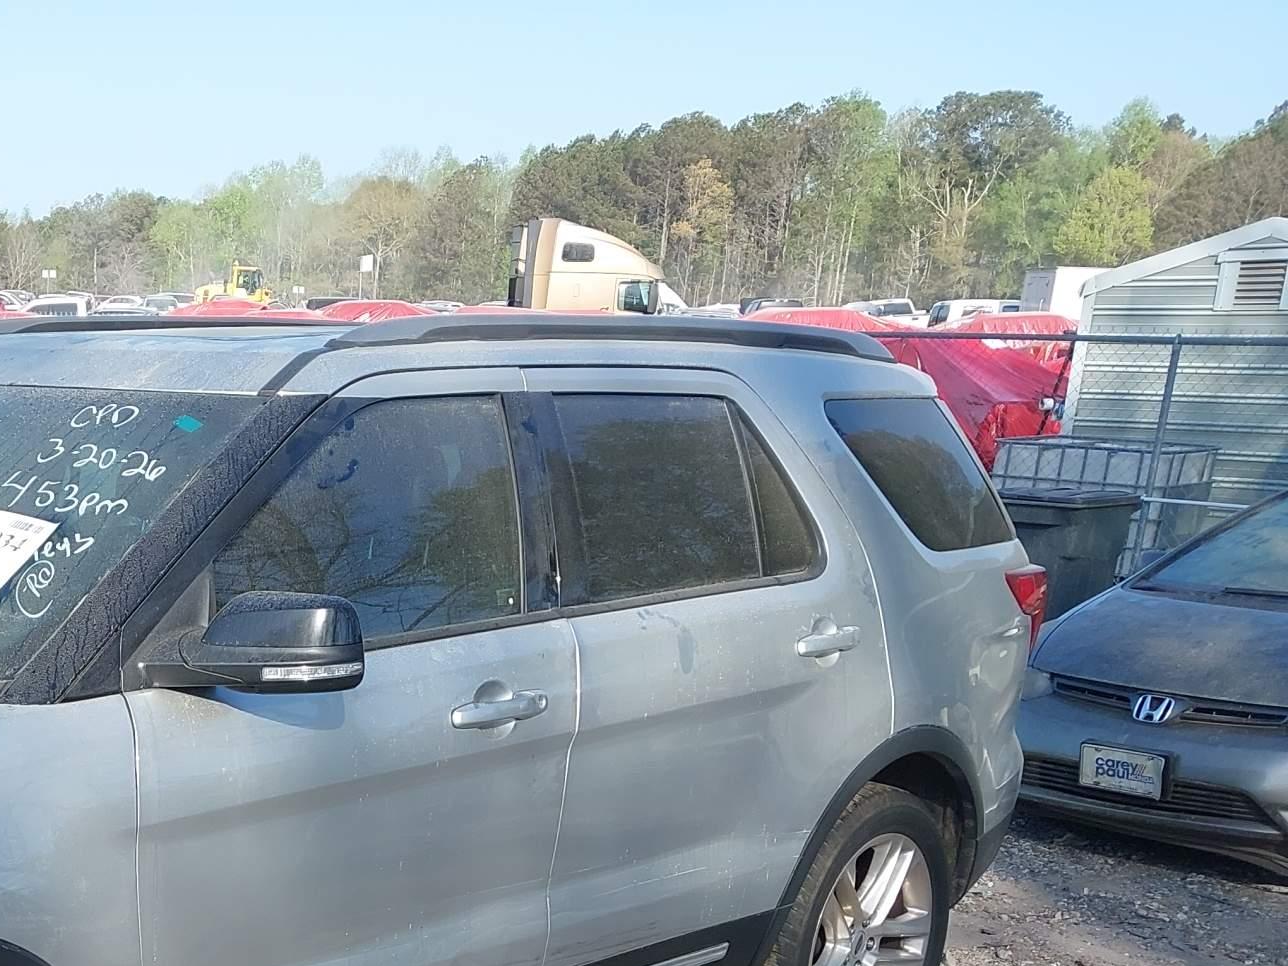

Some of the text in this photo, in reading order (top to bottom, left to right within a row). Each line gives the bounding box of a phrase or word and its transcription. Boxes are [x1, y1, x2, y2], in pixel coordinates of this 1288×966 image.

[70, 403, 140, 428] CPD
[1095, 757, 1138, 776] carey
[1095, 766, 1130, 780] paul
